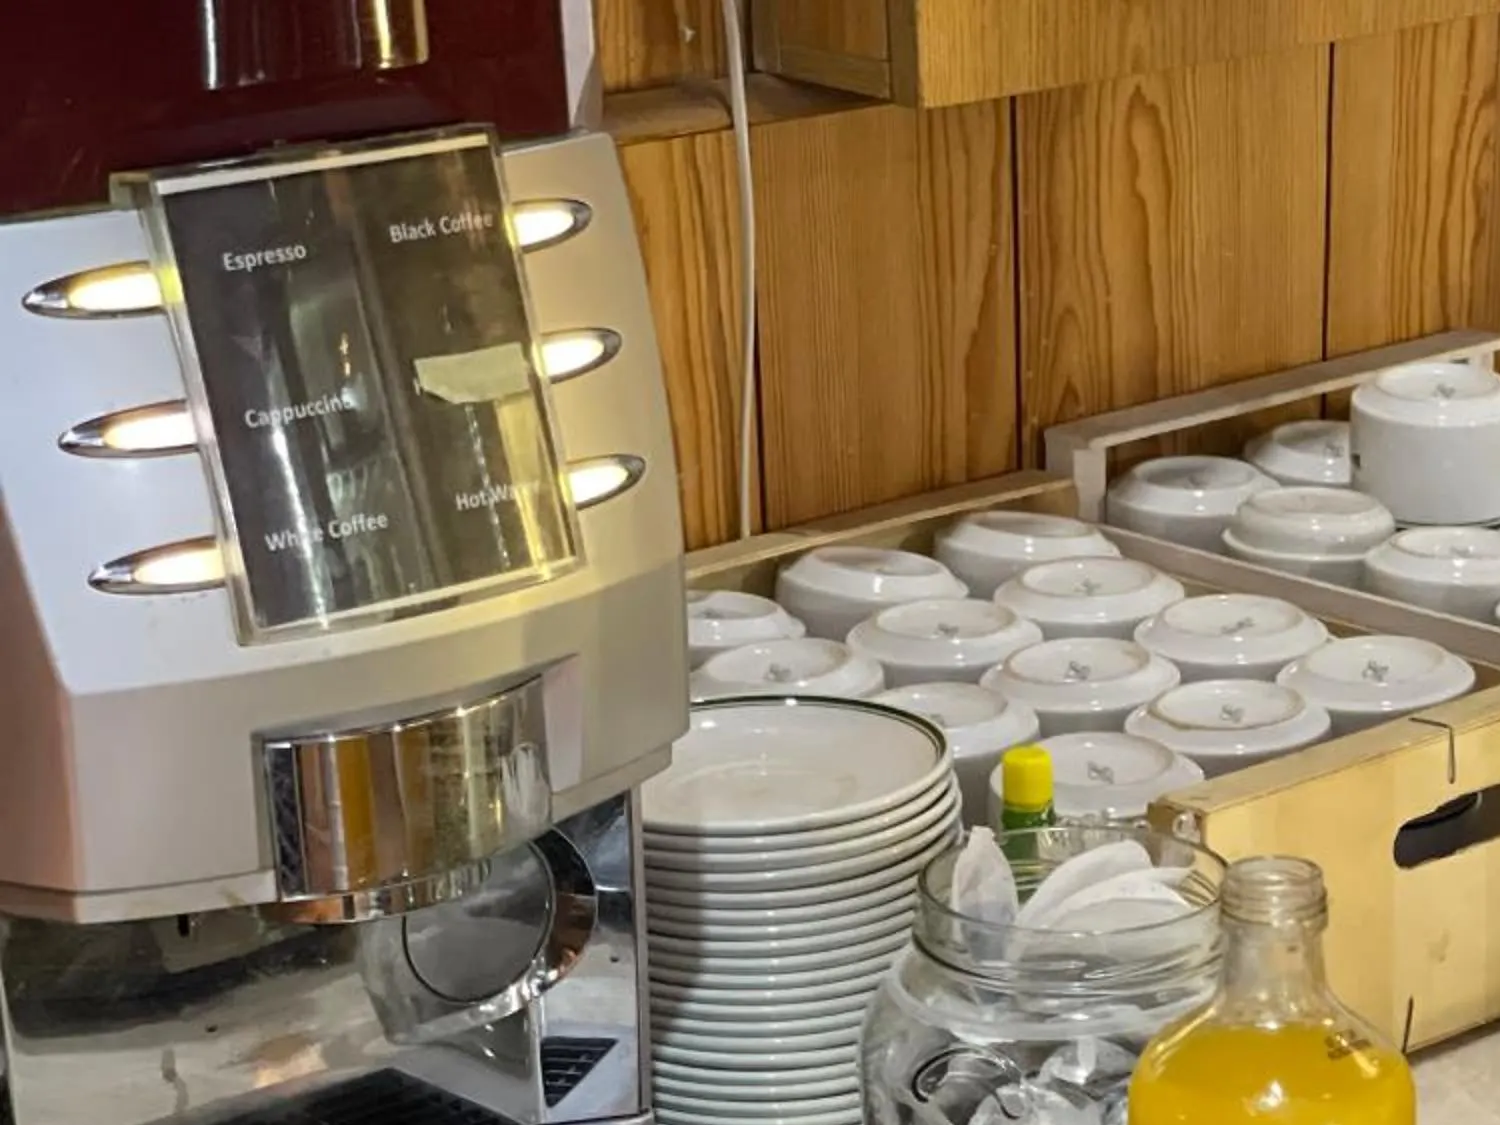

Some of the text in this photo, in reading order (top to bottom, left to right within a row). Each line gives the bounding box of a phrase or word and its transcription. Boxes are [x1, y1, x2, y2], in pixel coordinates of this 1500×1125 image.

[389, 211, 493, 244] Black Coffee
[223, 245, 307, 273] Espresso
[244, 392, 353, 429] Cappuccino
[455, 489, 489, 511] Hot
[264, 513, 388, 552] Whe Coffee
